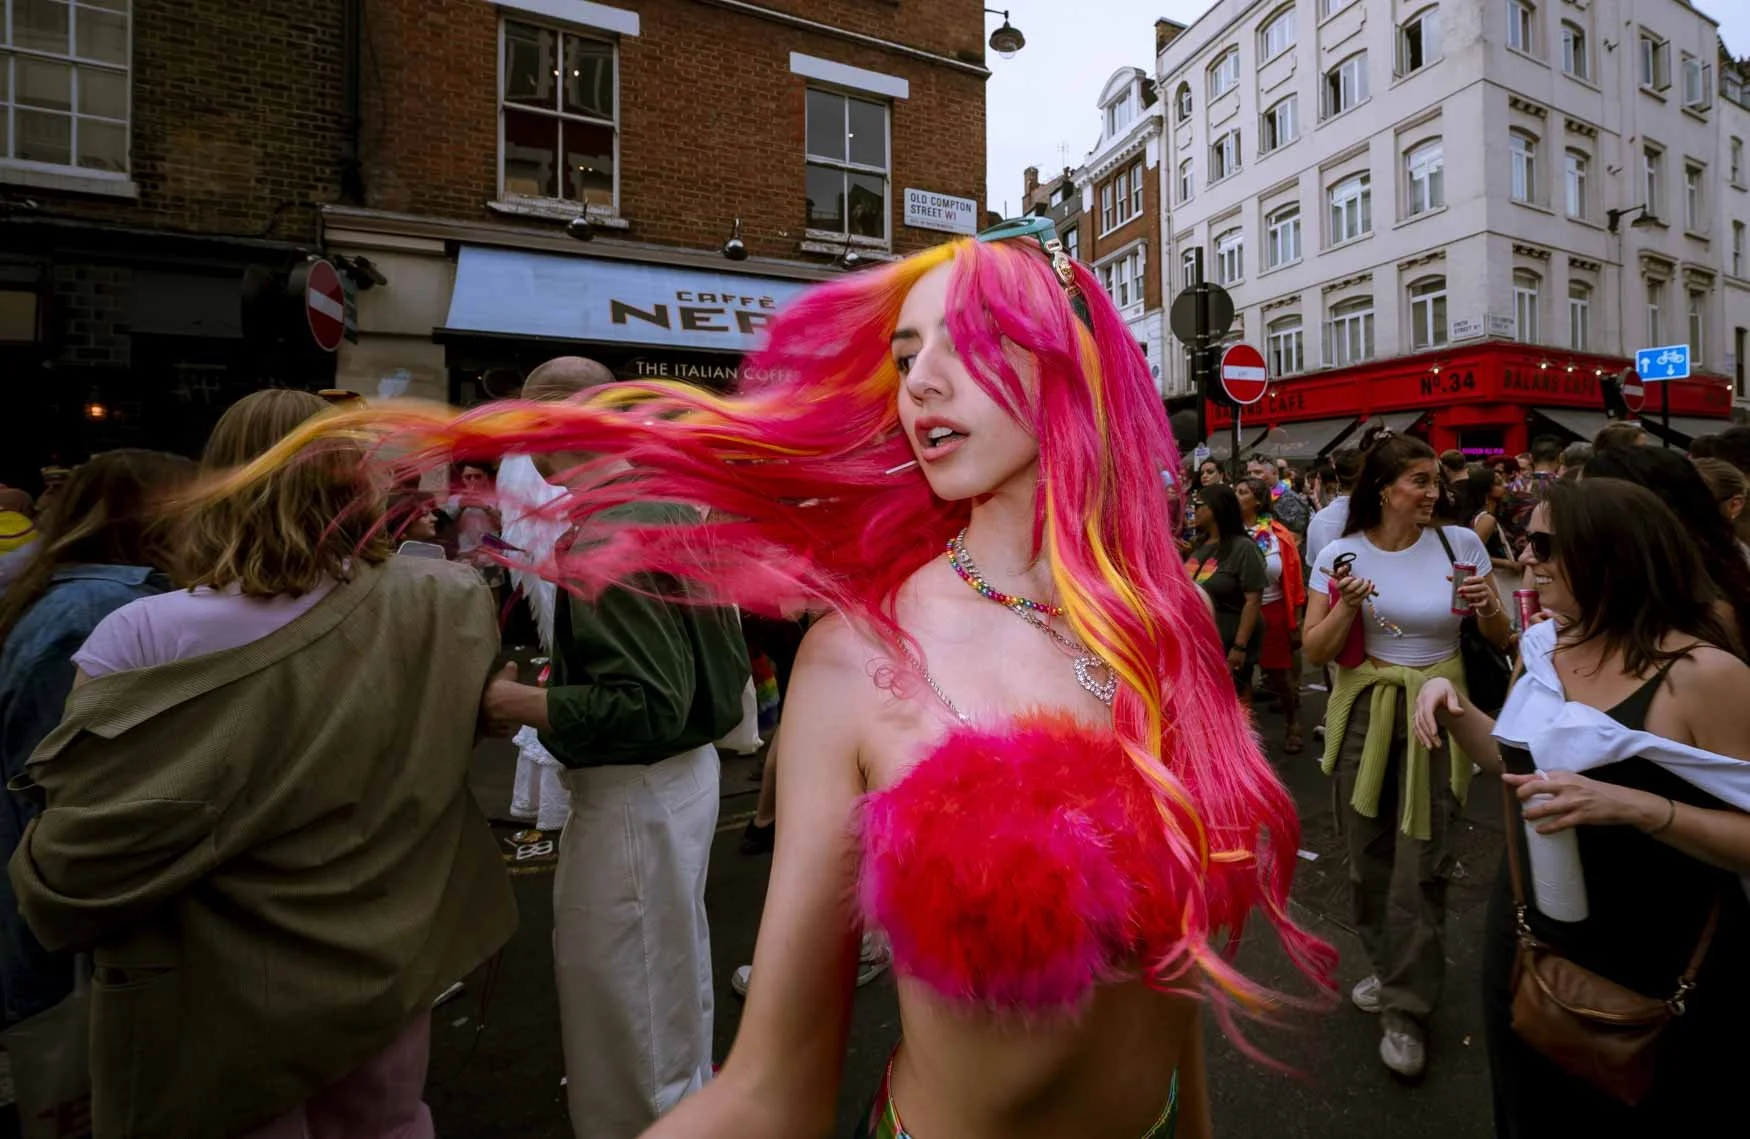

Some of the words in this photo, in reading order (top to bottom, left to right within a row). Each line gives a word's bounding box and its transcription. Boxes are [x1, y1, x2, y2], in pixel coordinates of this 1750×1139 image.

[910, 193, 927, 204] OLD
[931, 196, 971, 212] COMPTON
[910, 204, 941, 218] STREET
[610, 299, 775, 335] NER
[636, 361, 668, 377] THE
[675, 363, 738, 380] ITALIAN
